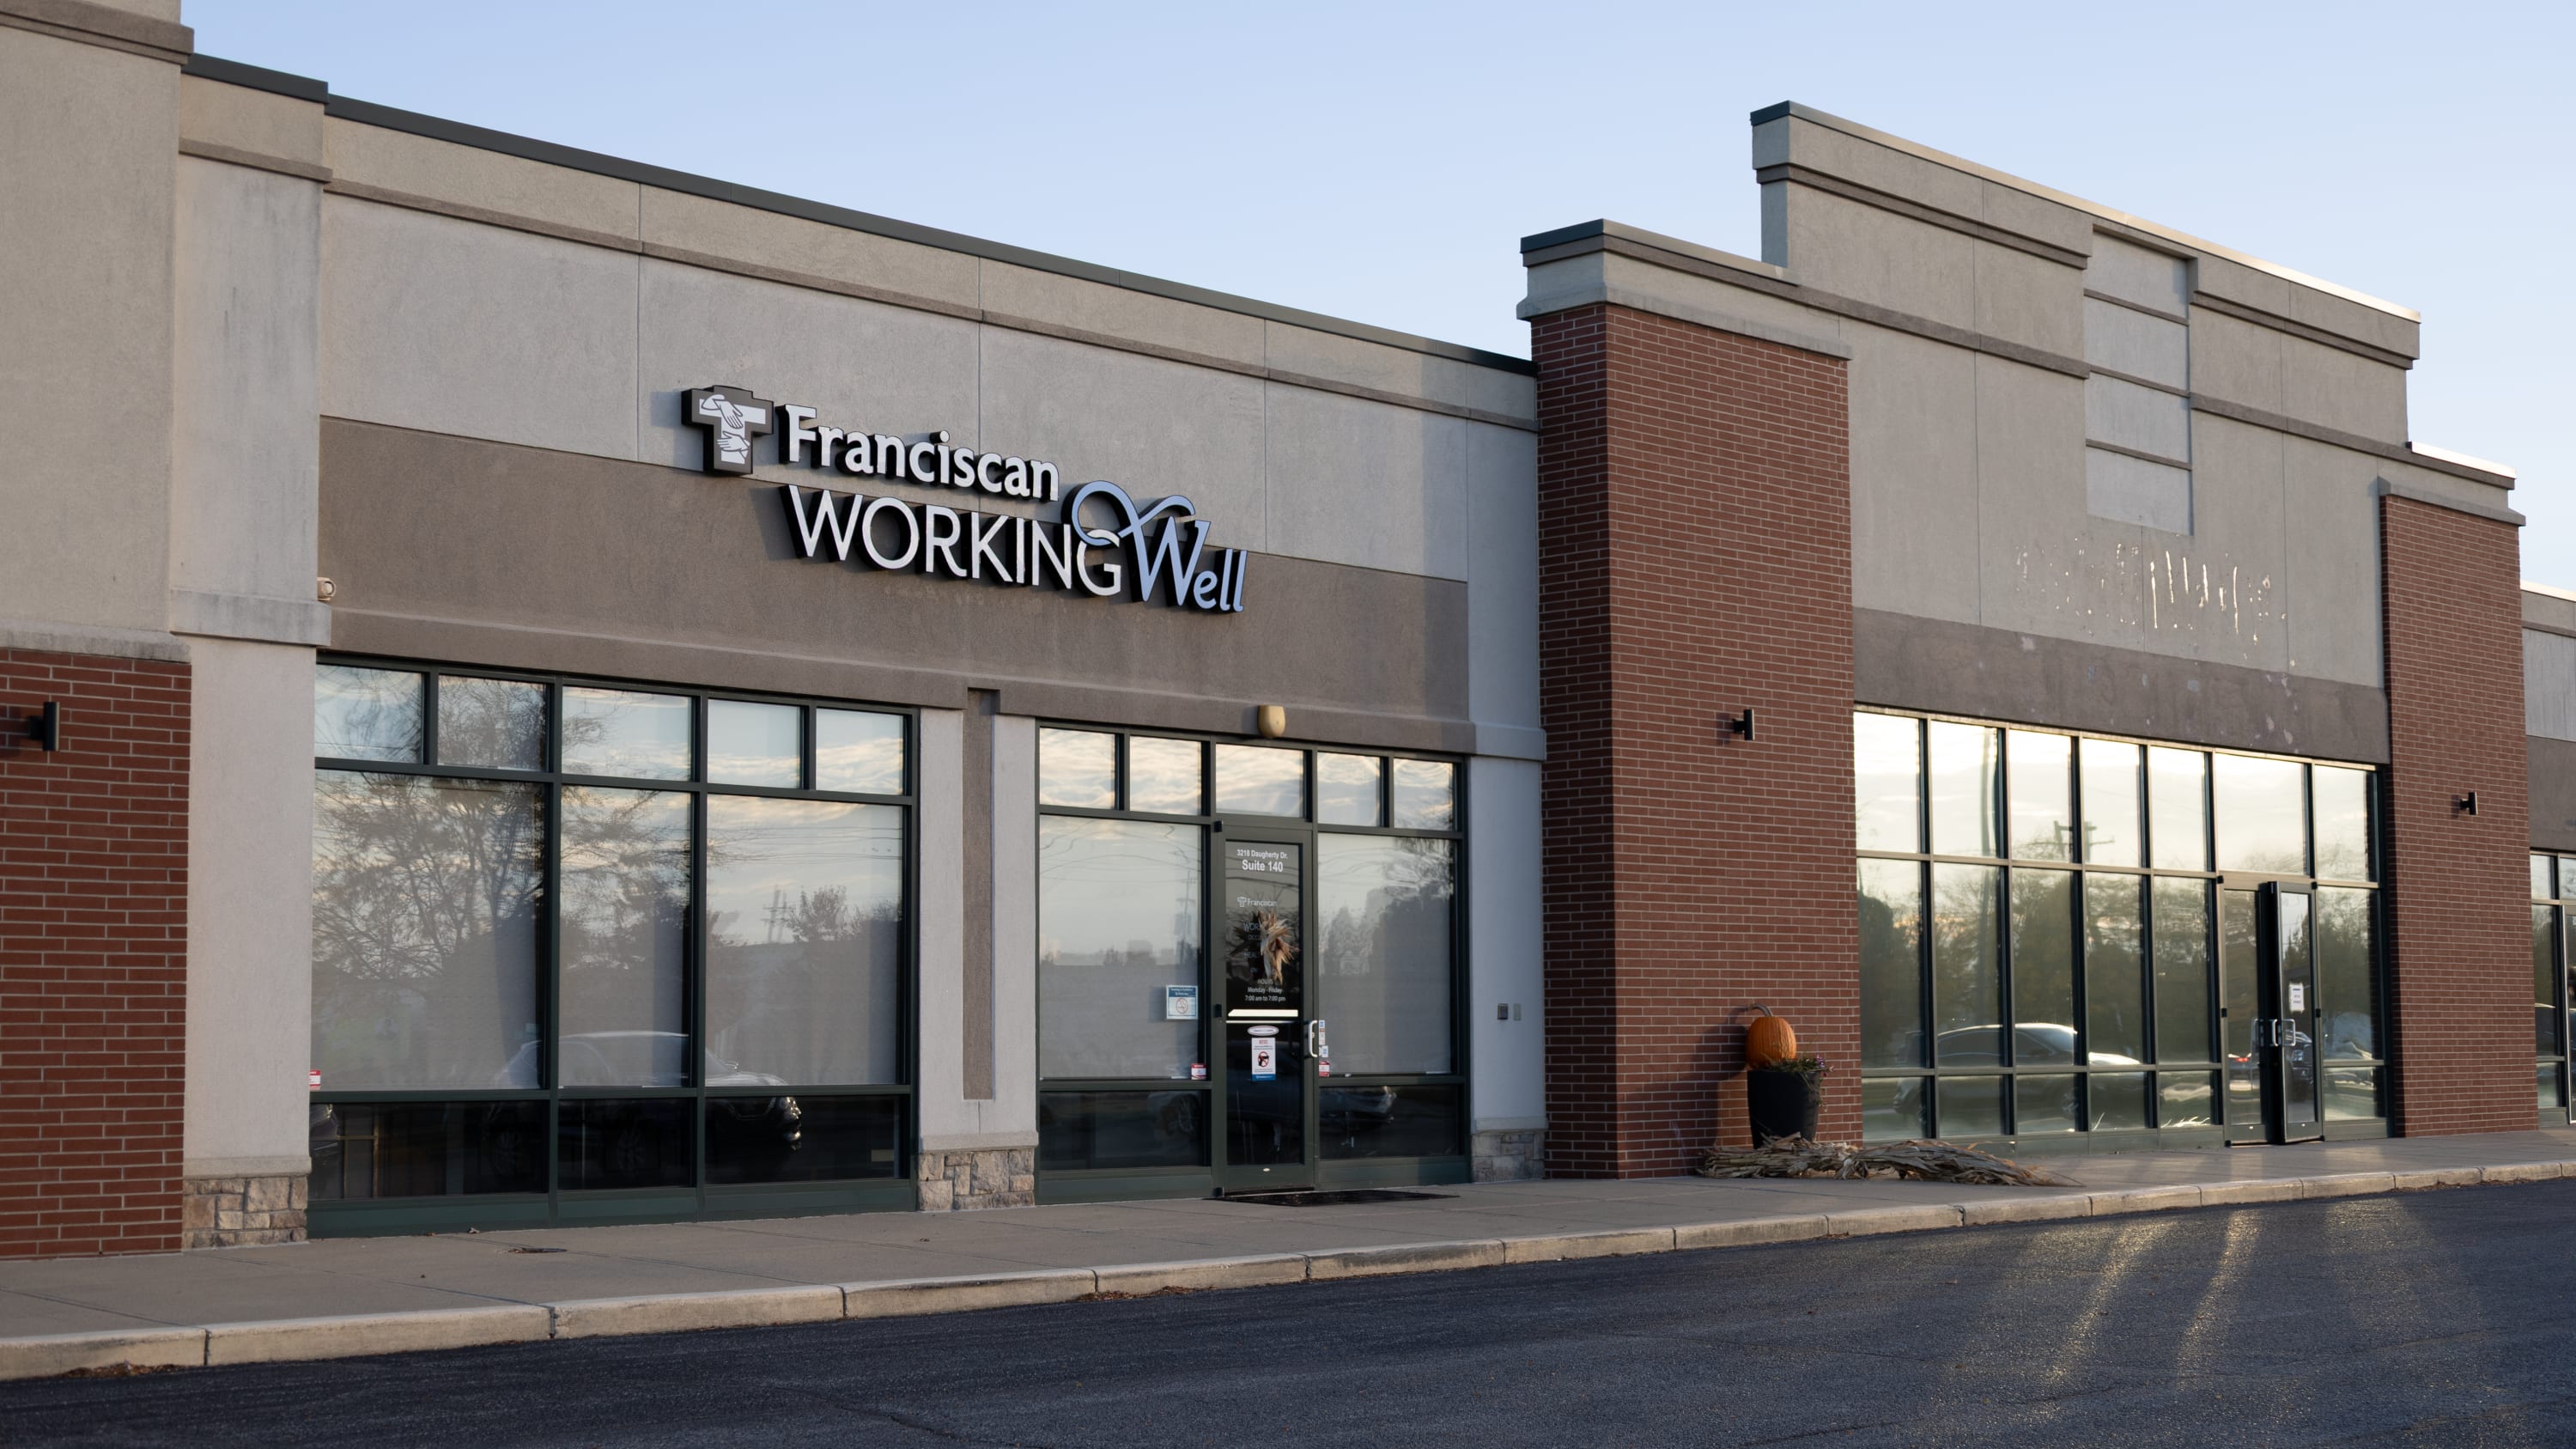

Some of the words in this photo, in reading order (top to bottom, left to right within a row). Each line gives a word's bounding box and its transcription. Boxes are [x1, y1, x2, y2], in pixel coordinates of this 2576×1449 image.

[780, 404, 1060, 502] Franciscan
[783, 484, 1121, 596] WORKING
[1069, 480, 1248, 612] Well
[1251, 849, 1279, 859] Daugherty
[1242, 859, 1266, 871] Suite
[1267, 861, 1284, 873] 140
[1247, 898, 1278, 907] Franciscan
